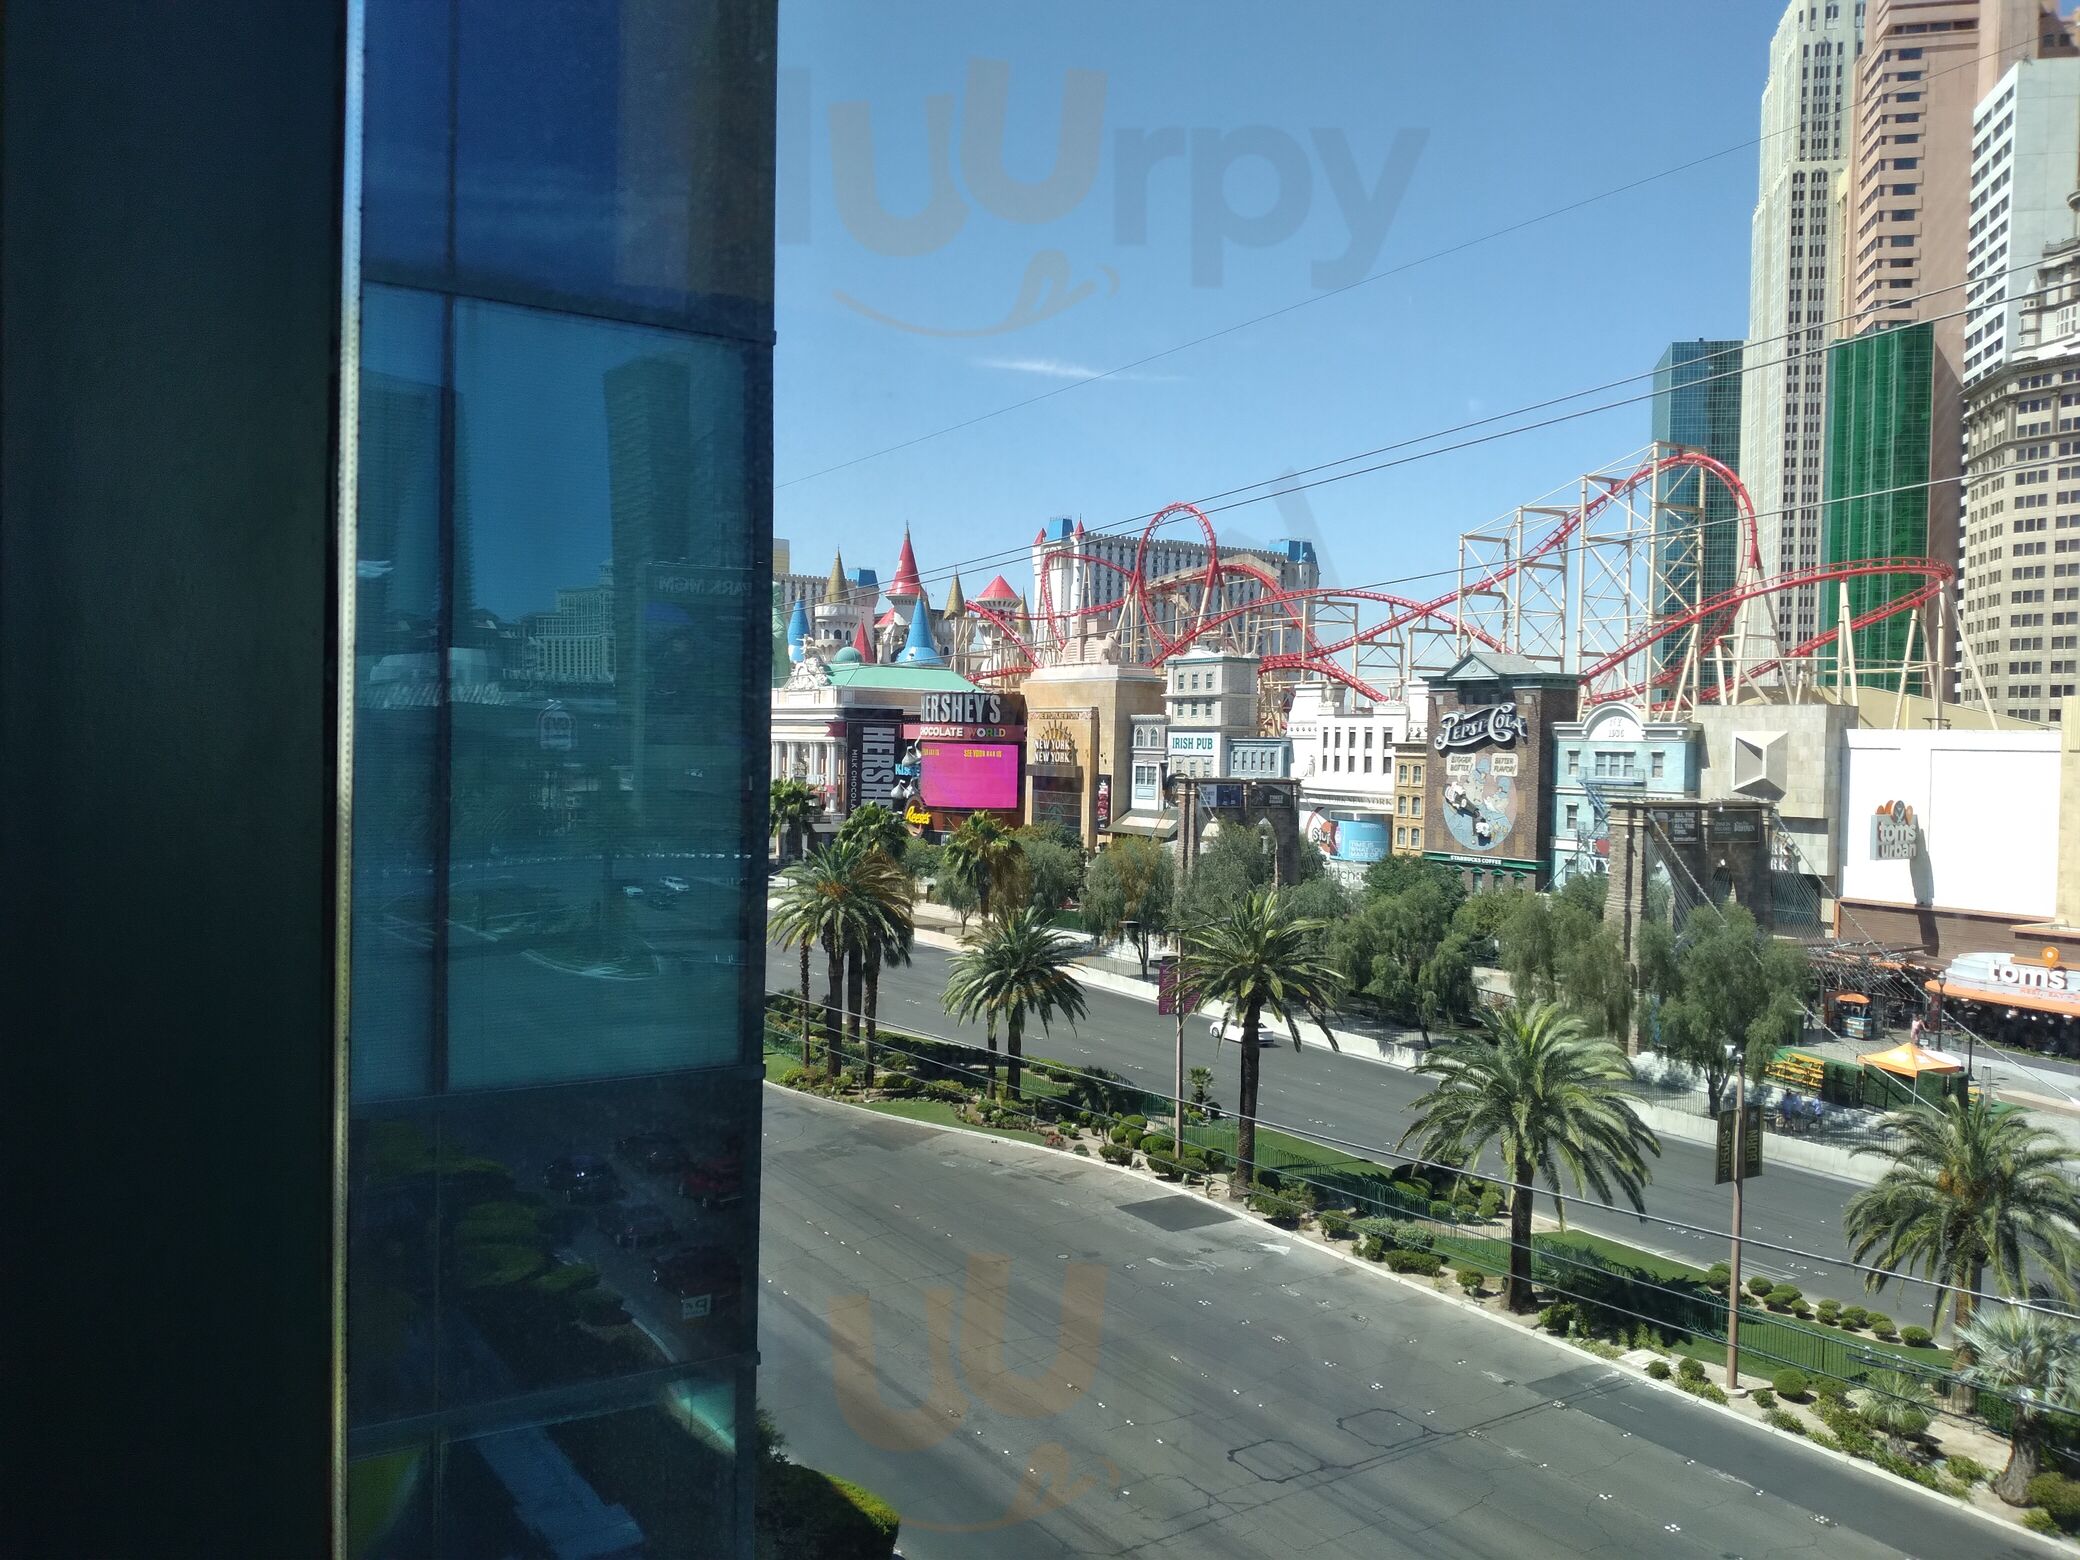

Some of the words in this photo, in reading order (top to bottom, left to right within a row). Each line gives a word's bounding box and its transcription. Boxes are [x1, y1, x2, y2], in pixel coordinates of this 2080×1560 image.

[920, 693, 1001, 724] HERSHEY'S
[969, 727, 1006, 737] WORLD
[1034, 739, 1050, 750] NEW
[1051, 739, 1071, 750] YORK
[1172, 737, 1194, 750] IRISH
[1196, 737, 1213, 750] PUB
[1034, 751, 1050, 763] NEW
[1051, 751, 1071, 763] YORK
[1367, 797, 1392, 805] YORK
[1879, 821, 1916, 841] toms
[1880, 841, 1917, 857] urban
[1988, 960, 2066, 990] toms
[1720, 1130, 1731, 1170] VEGAS
[1746, 1129, 1759, 1162] BORN
